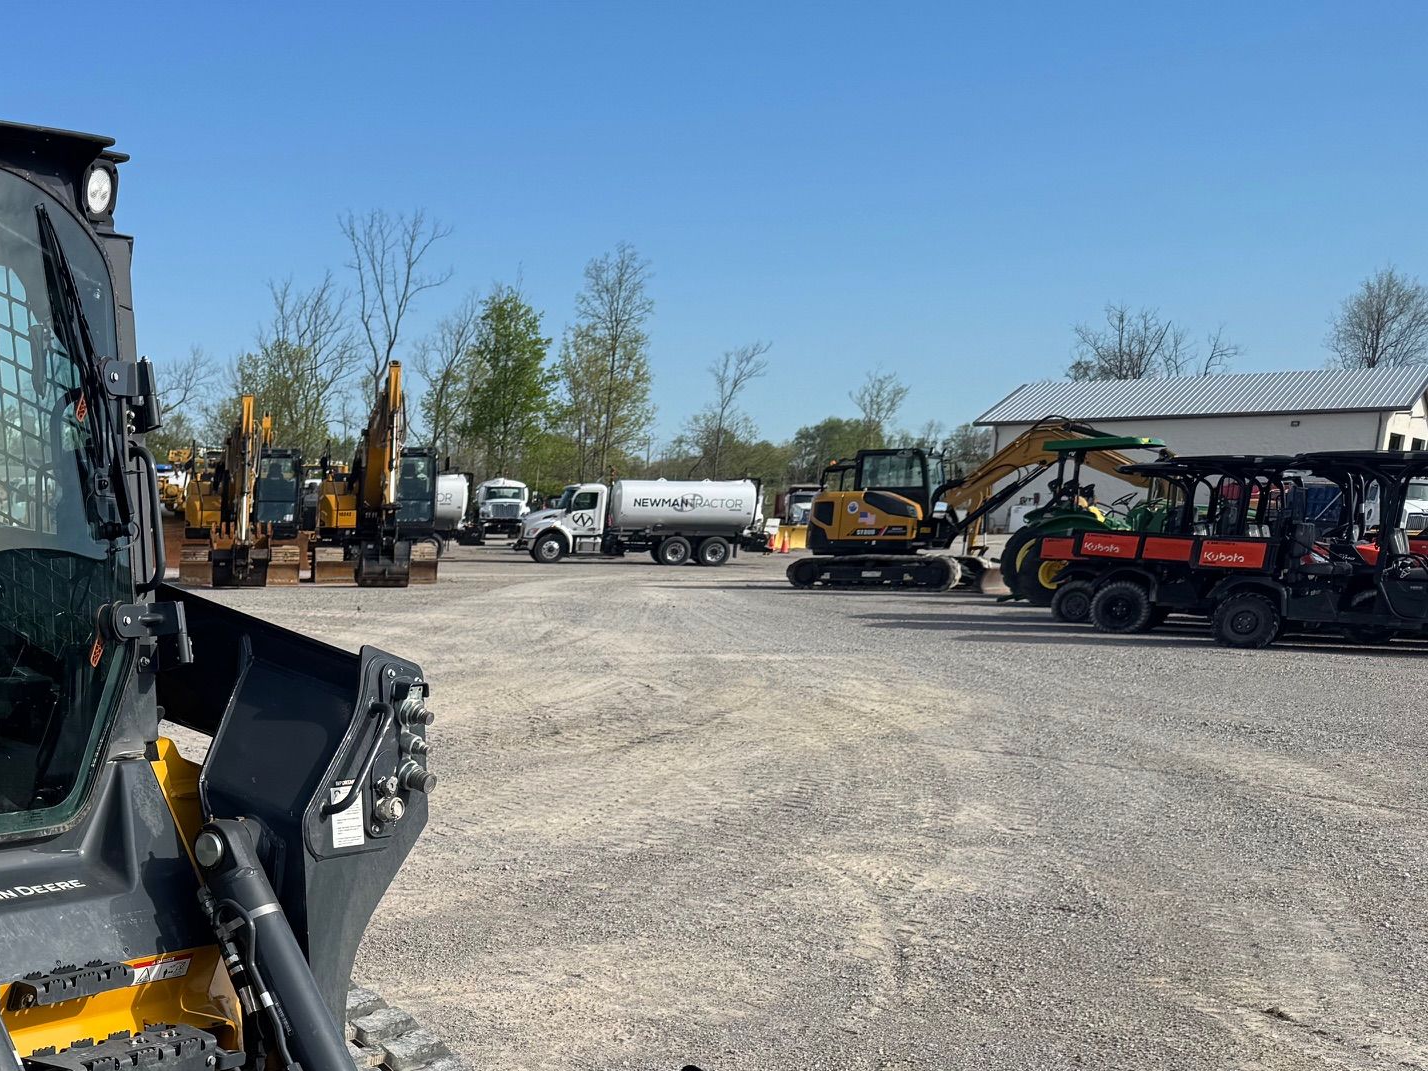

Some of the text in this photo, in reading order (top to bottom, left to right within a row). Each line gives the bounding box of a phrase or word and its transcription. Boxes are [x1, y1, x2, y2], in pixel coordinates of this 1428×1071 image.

[1084, 541, 1120, 554] Kubota
[1203, 550, 1245, 563] Kubota
[13, 879, 86, 896] DEERE
